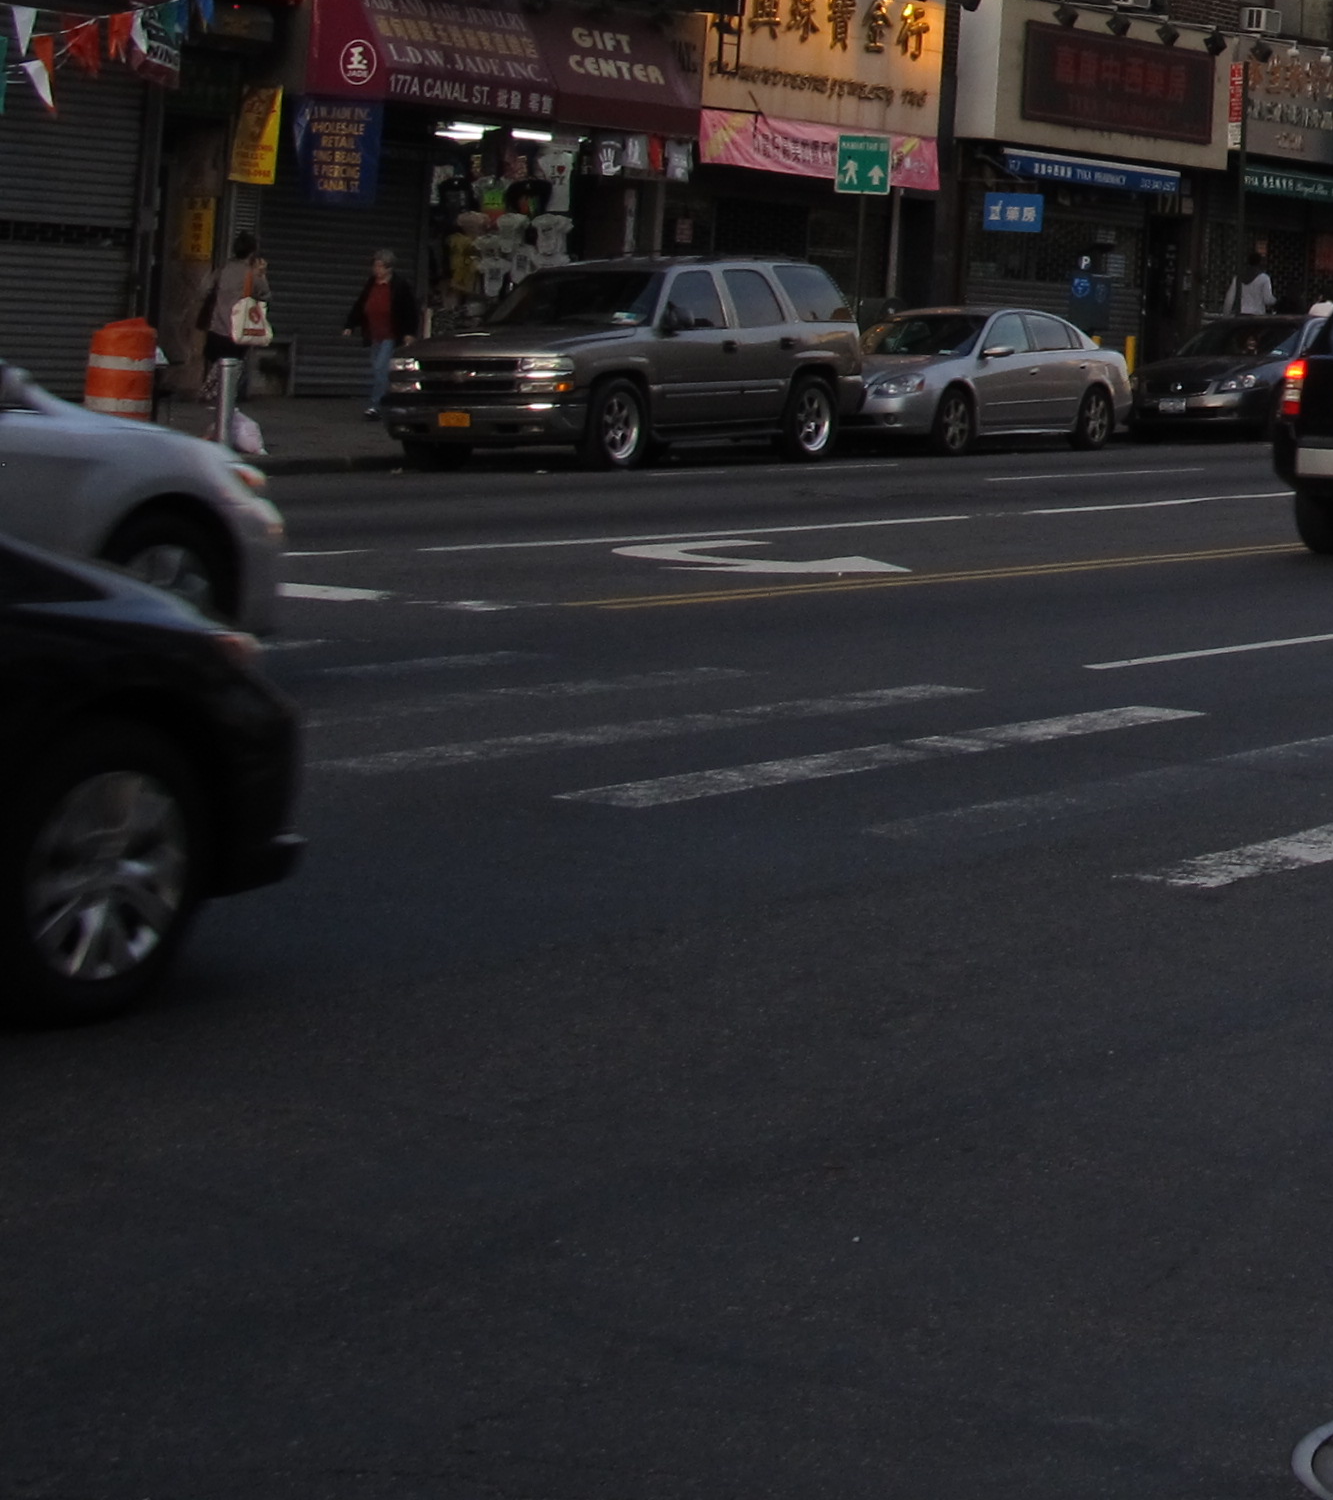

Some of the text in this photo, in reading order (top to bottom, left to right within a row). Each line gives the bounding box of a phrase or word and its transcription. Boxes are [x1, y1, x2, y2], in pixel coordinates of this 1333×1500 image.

[571, 27, 632, 55] GIFT
[455, 55, 501, 77] JADE
[508, 61, 549, 84] INC.
[568, 54, 666, 86] CENTER
[389, 73, 421, 96] 177A
[424, 78, 470, 103] CANAL
[473, 86, 492, 106] ST.
